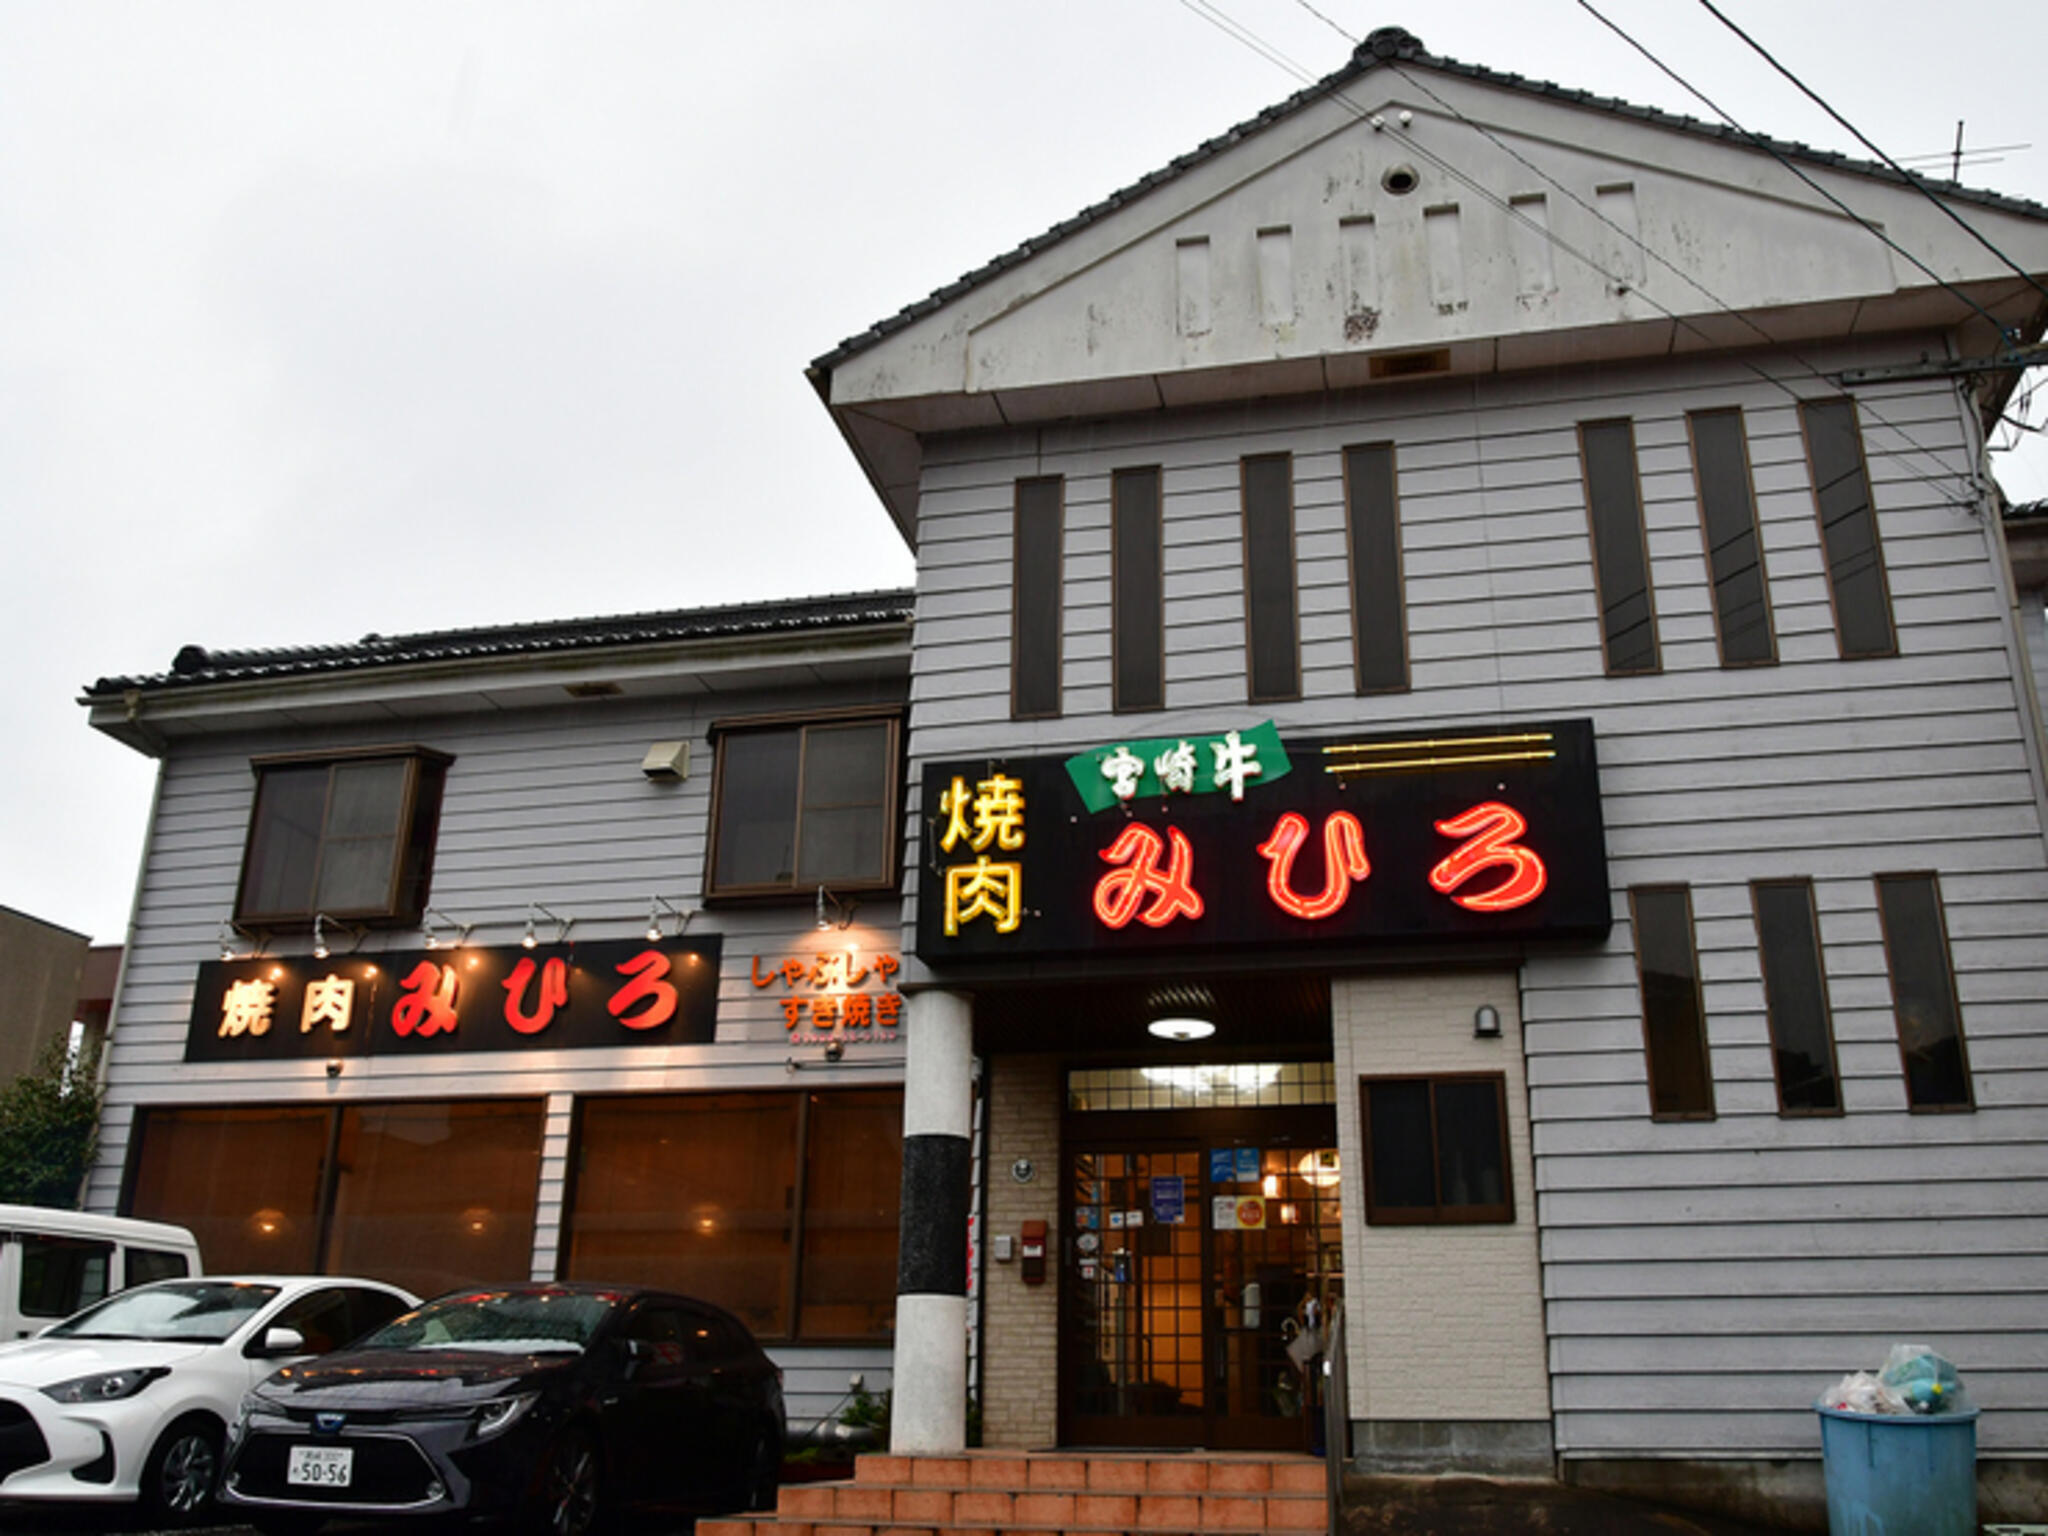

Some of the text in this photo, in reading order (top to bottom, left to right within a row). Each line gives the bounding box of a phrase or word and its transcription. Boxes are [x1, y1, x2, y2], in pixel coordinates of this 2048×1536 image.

[1100, 730, 1263, 802] 宮崎牛
[940, 773, 1025, 936] 焼肉
[1092, 801, 1547, 929] みひろ
[217, 950, 678, 1038] 焼肉 みひろ
[780, 993, 902, 1029] すき焼き
